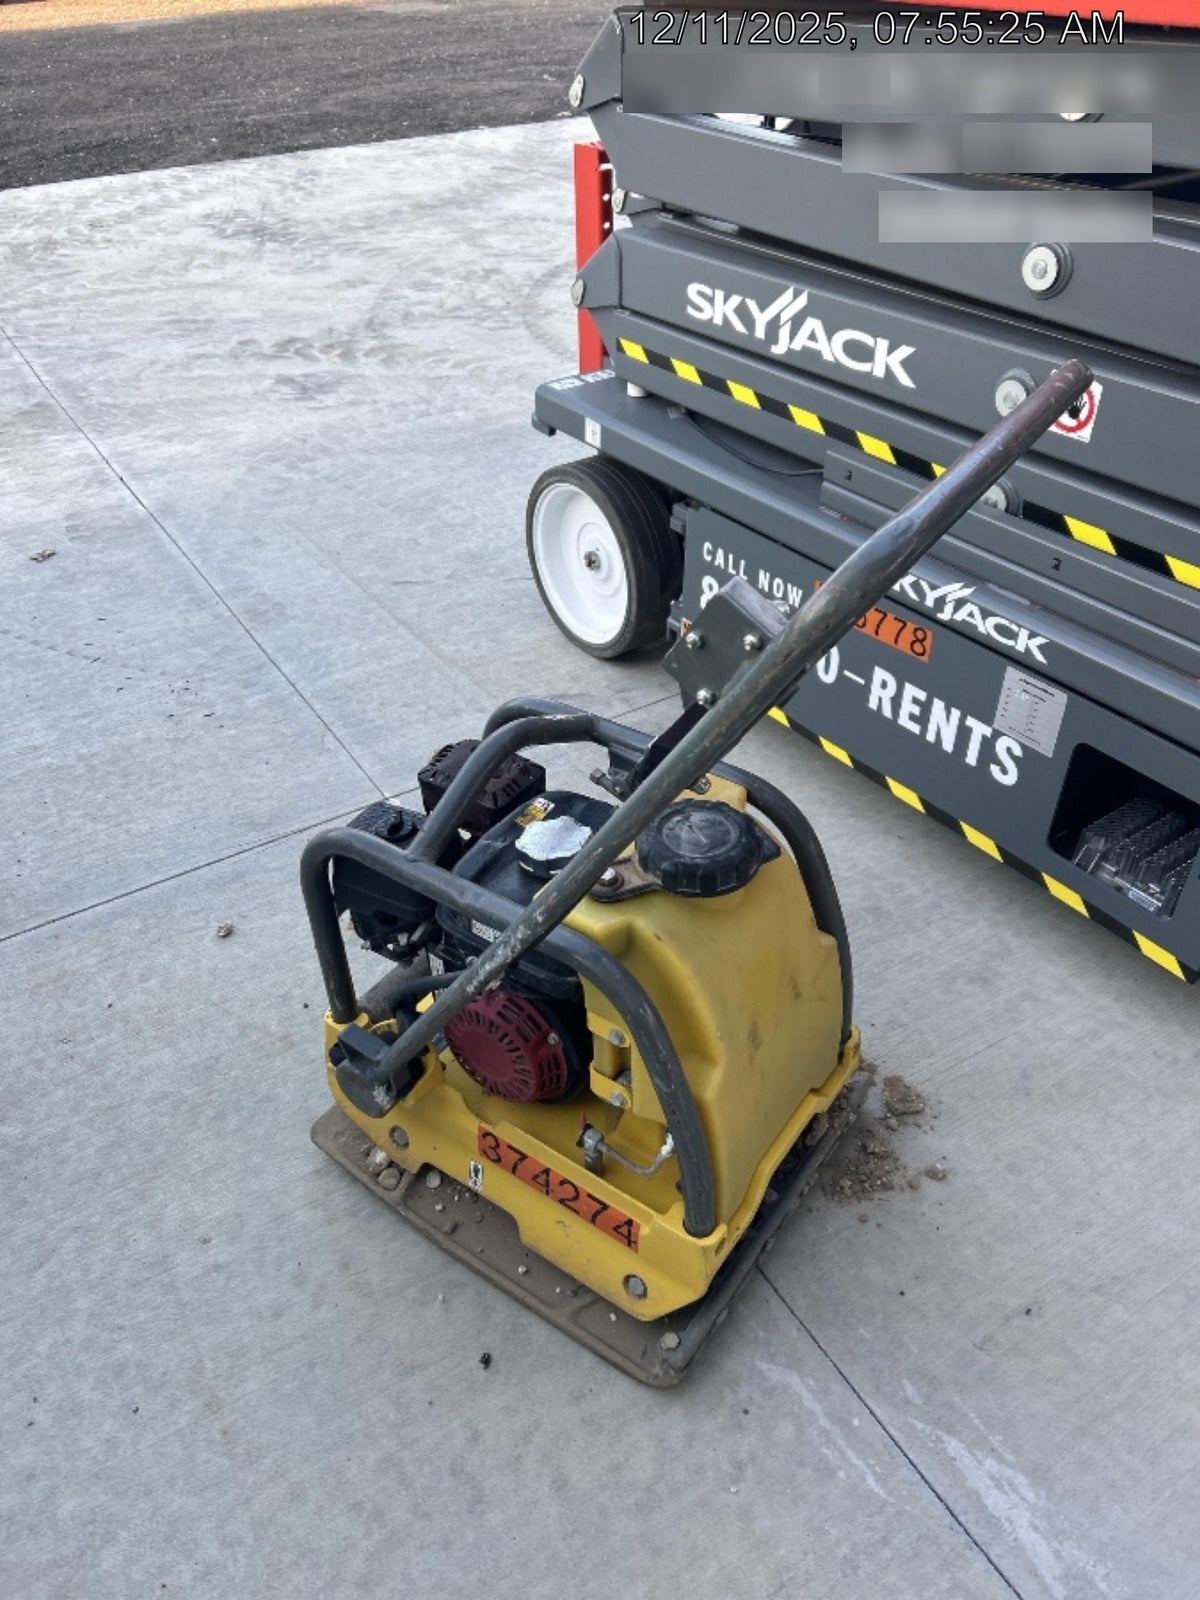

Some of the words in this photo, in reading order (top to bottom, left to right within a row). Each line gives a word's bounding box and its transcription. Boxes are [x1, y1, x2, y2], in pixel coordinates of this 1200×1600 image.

[686, 282, 917, 389] SKYJACK
[703, 541, 748, 580] CALL
[758, 568, 803, 608] NOW
[892, 572, 1050, 666] KYJACK
[480, 1131, 638, 1248] 374274
